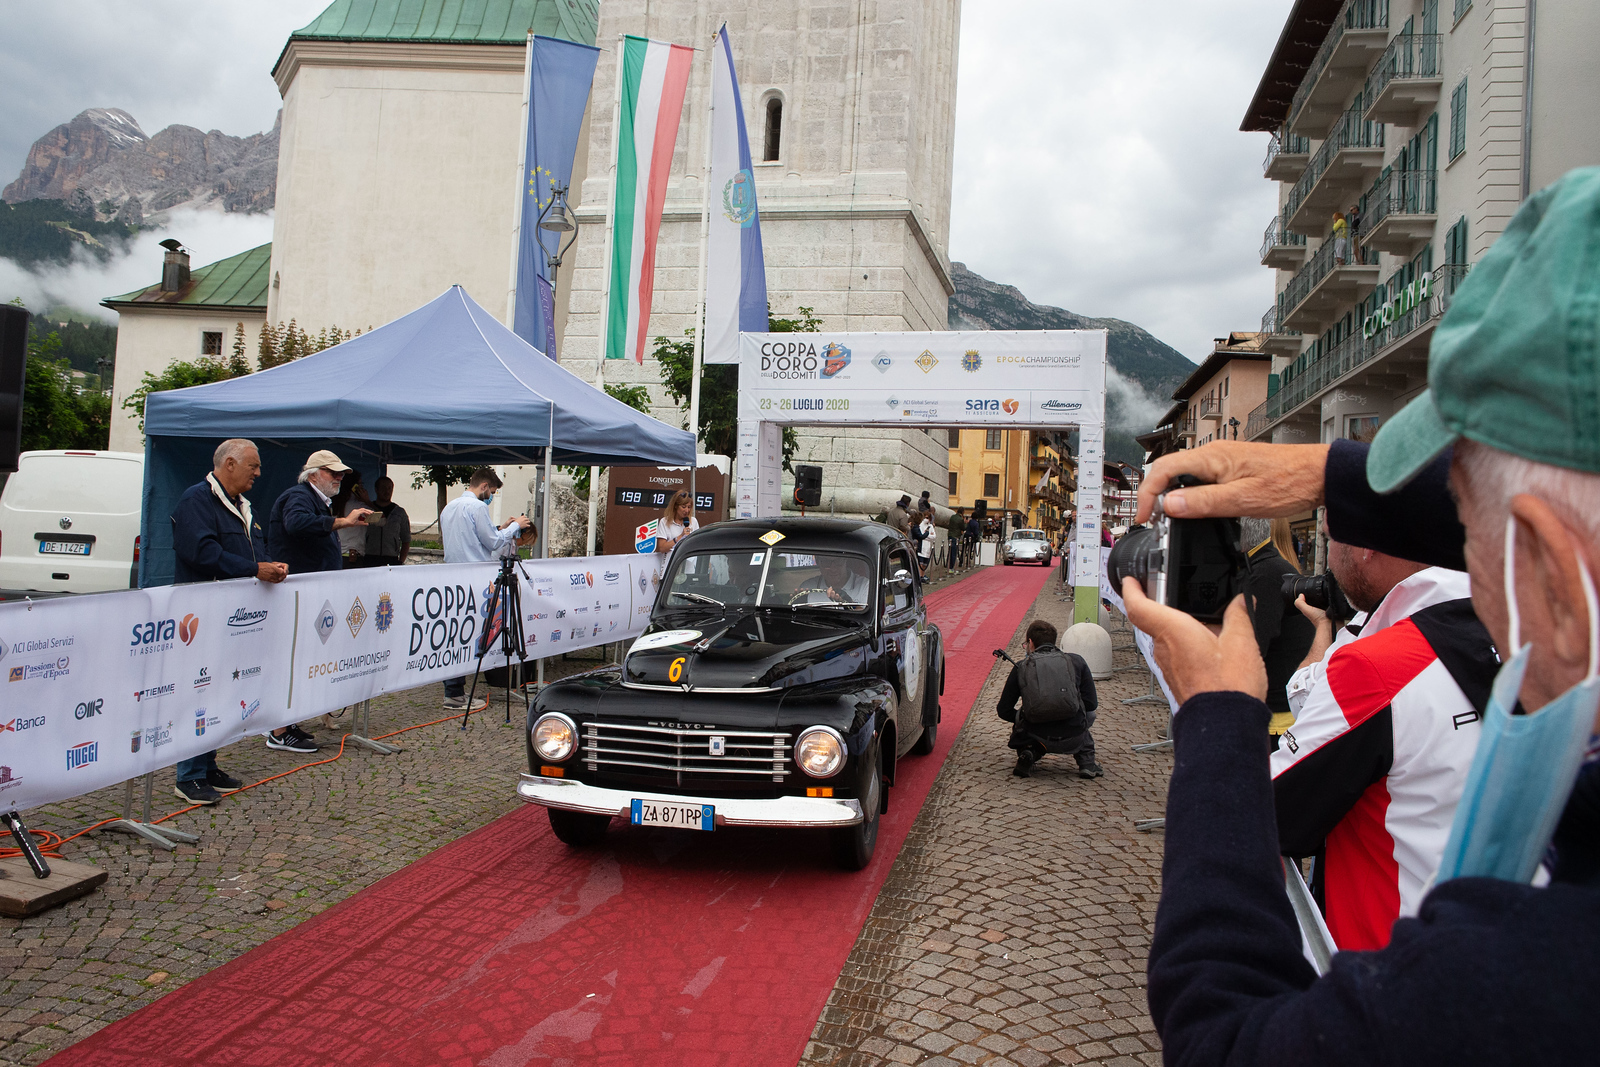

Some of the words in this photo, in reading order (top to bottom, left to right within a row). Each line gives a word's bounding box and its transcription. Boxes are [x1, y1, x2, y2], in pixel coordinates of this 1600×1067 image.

[1363, 272, 1433, 340] CORTINA
[761, 342, 817, 357] COPPA
[761, 357, 817, 371] D'ORO
[773, 371, 817, 379] DOLOMITI
[760, 398, 771, 410] 23
[780, 399, 791, 410] 26
[793, 399, 823, 410] LUGLIO
[826, 399, 849, 410] 2020
[965, 399, 999, 411] sara
[46, 543, 56, 551] DE
[570, 573, 586, 586] sara
[412, 584, 476, 622] COPPA
[228, 608, 268, 625] Allemano
[321, 615, 334, 628] ACI
[131, 619, 176, 646] sara
[409, 615, 475, 656] D'ORO
[12, 642, 25, 654] ACI
[27, 639, 49, 651] Global
[50, 635, 74, 648] Servizi
[140, 642, 174, 656] ASSICURA
[406, 658, 421, 671] DELLE
[420, 646, 471, 671] DOLOMITI
[24, 662, 55, 680] Passione
[43, 668, 69, 680] d'Epoca
[241, 666, 261, 676] RANGERS
[669, 657, 686, 683] 6
[145, 683, 175, 697] TIEMME
[16, 715, 45, 731] Banca
[67, 741, 98, 771] FIUGGI
[643, 805, 658, 821] ZA
[663, 807, 702, 825] 871PP
